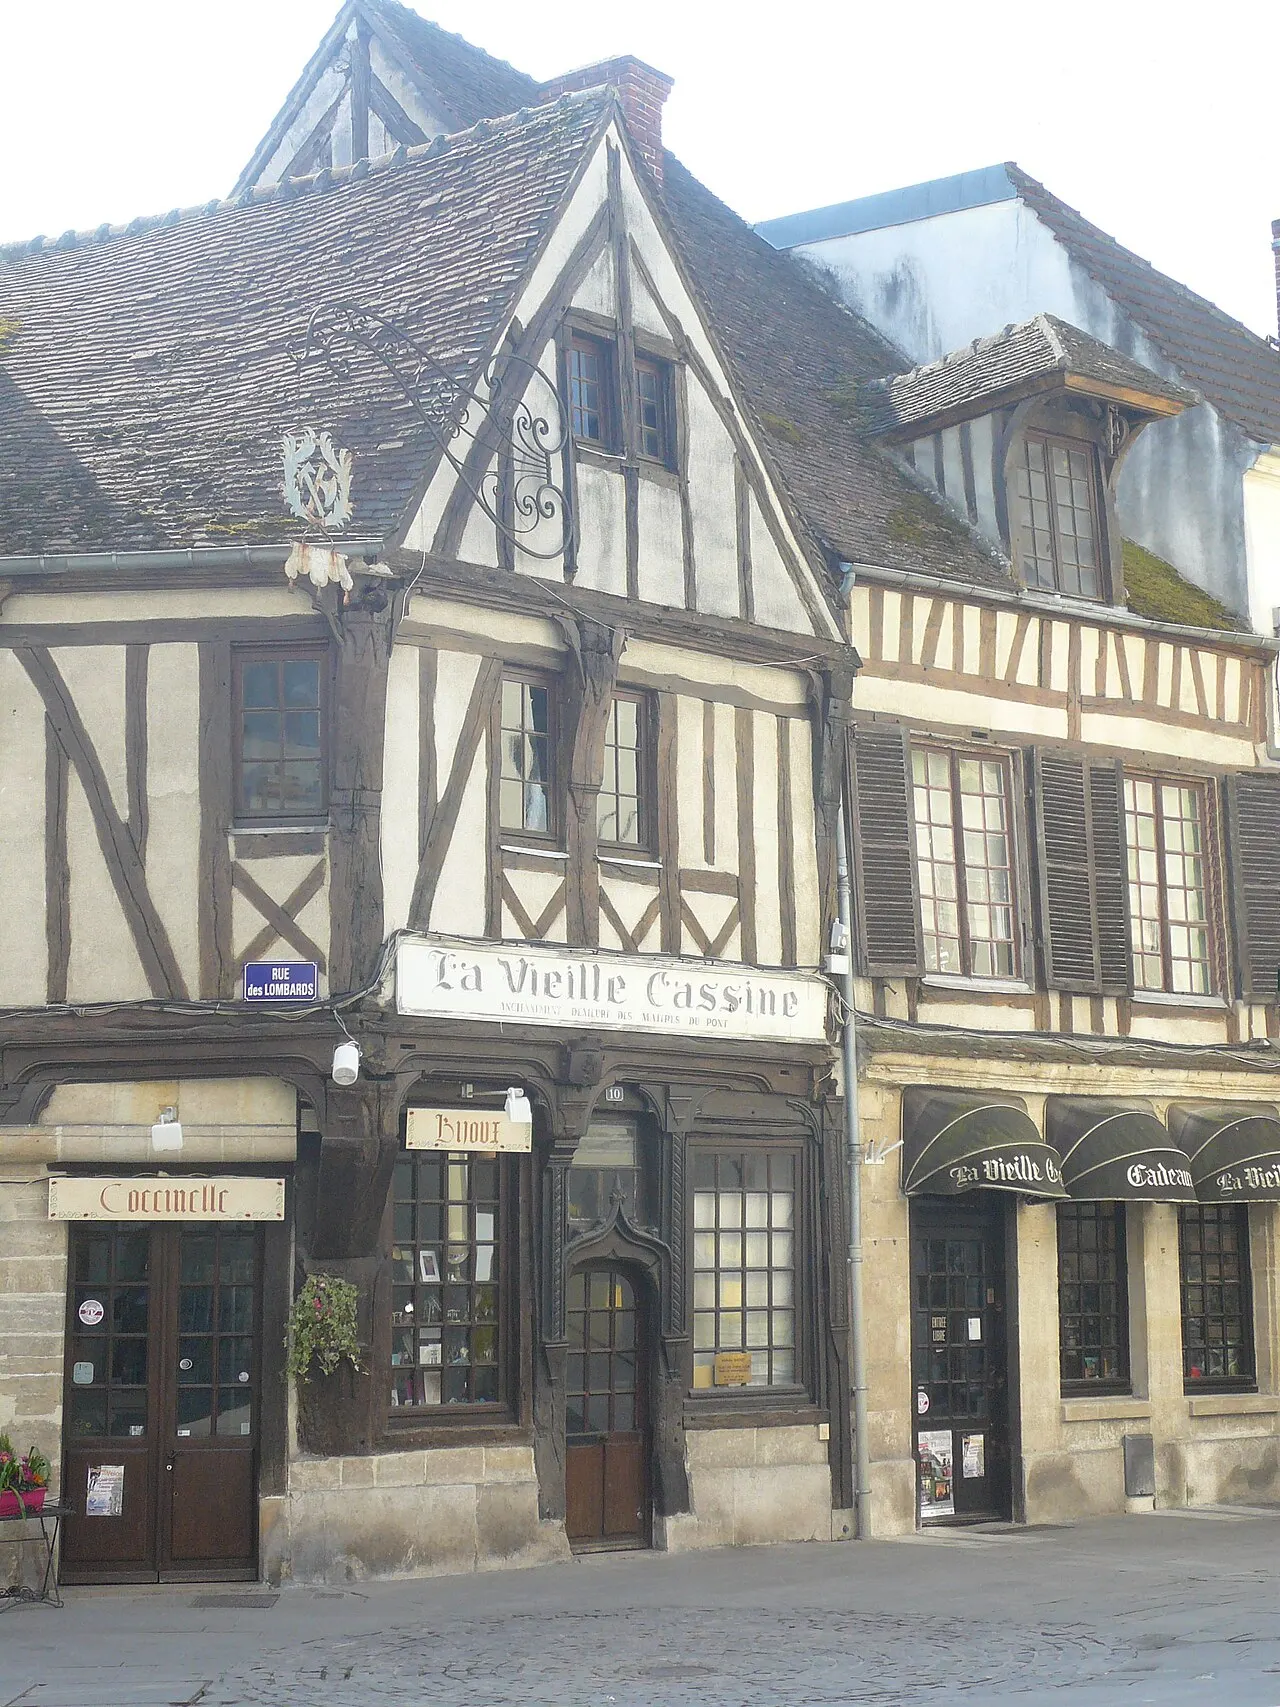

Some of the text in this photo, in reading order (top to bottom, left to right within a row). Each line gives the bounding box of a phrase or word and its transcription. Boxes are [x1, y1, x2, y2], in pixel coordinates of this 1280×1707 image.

[272, 967, 290, 981] RUE
[427, 949, 799, 1018] La Vieille Cassine
[247, 983, 314, 996] des LOMBARDS
[617, 1010, 633, 1020] DES
[688, 1016, 700, 1026] DU
[706, 1017, 729, 1029] PONT
[609, 1088, 620, 1099] 10
[949, 1166, 980, 1188] La
[982, 1155, 1044, 1181] Vieille
[1216, 1172, 1243, 1197] La
[99, 1183, 229, 1213] Coccinelle
[933, 1330, 946, 1342] LIBRE
